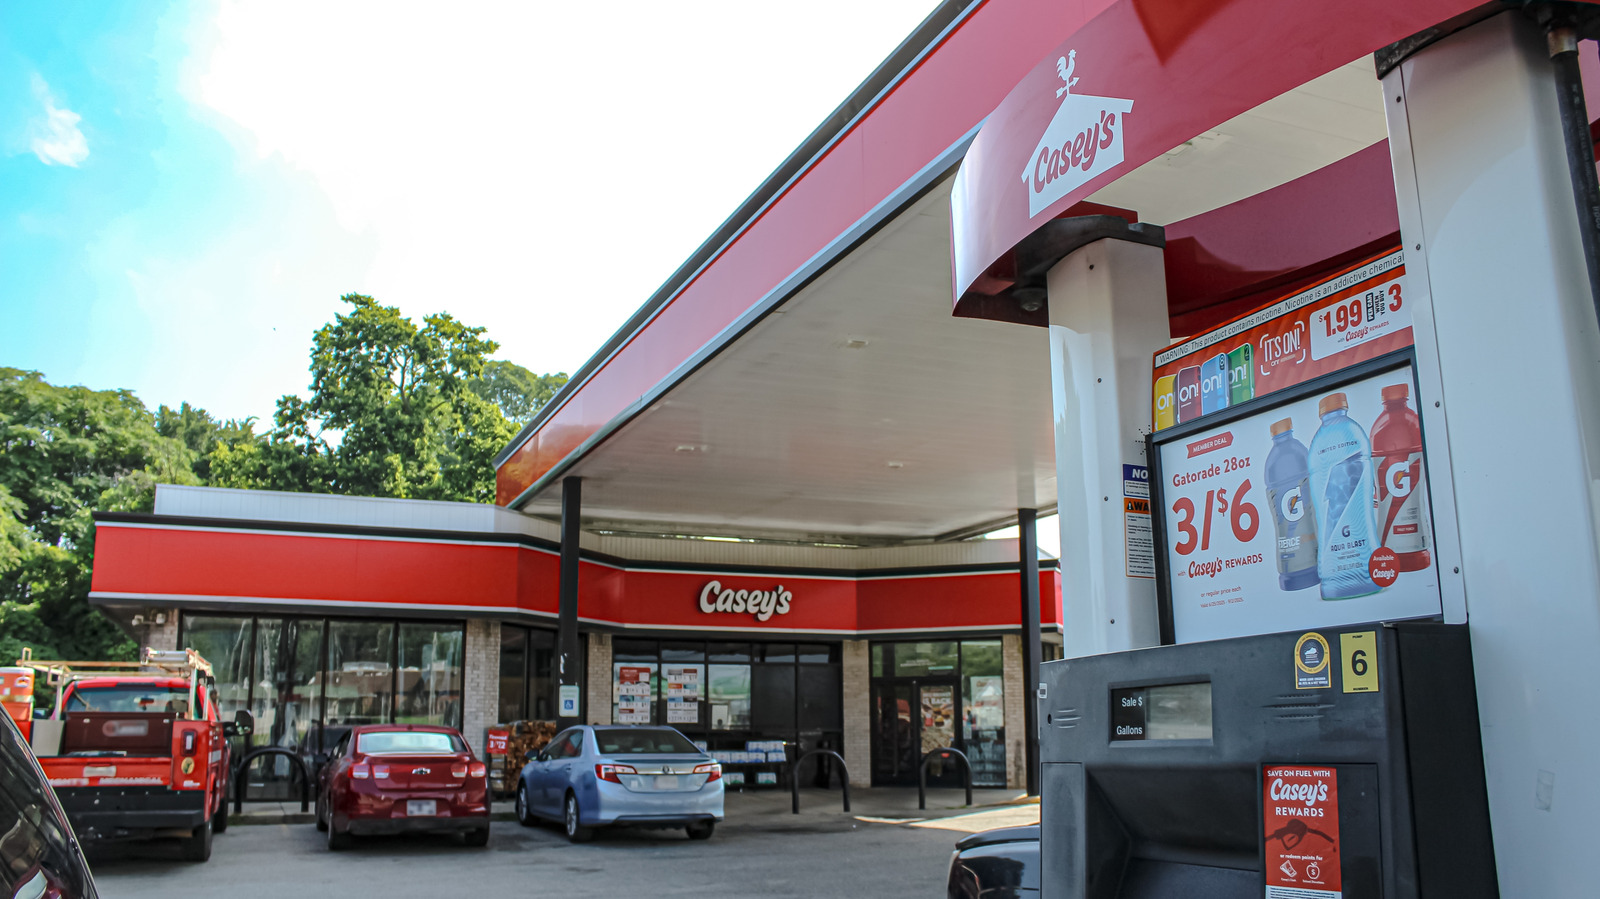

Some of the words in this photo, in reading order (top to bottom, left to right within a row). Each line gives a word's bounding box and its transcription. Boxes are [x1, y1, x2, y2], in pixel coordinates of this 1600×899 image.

[1033, 109, 1116, 193] Casey's
[1160, 345, 1190, 363] WARNING:
[1191, 340, 1203, 350] This
[1204, 330, 1227, 346] product
[1228, 318, 1255, 335] contains
[1255, 306, 1284, 323] nicotine.
[1285, 292, 1314, 311] Nicotine
[1315, 290, 1322, 299] is
[1323, 285, 1332, 295] an
[1333, 269, 1367, 290] addictive
[1369, 252, 1405, 275] chemical
[1388, 283, 1403, 313] 3
[1319, 299, 1362, 337] $1.99
[1283, 328, 1301, 355] ON!
[1345, 326, 1369, 342] Casey's
[1369, 321, 1390, 332] REWARDS
[1179, 382, 1200, 403] on!
[1202, 373, 1223, 394] on!
[1193, 440, 1214, 453] MEMBER
[1214, 437, 1228, 446] DEAL
[1317, 445, 1337, 456] LIMITED
[1338, 440, 1358, 449] EDITION
[1172, 463, 1221, 487] Gatorade
[1223, 456, 1251, 474] 28oz
[1385, 460, 1411, 498] G
[1281, 485, 1305, 522] G
[1341, 525, 1351, 538] G
[1331, 543, 1346, 552] AQUA
[1347, 539, 1367, 550] BLAST
[1188, 557, 1223, 579] Casey's
[1225, 553, 1263, 569] REWARDS
[1373, 554, 1395, 562] Available
[1372, 568, 1396, 580] Casey's
[700, 580, 793, 621] Casey's
[1206, 590, 1220, 598] regular
[1352, 649, 1368, 677] 6
[1121, 698, 1137, 708] Sale
[1138, 696, 1143, 707] $
[1116, 725, 1143, 735] Gallons
[1270, 778, 1329, 806] Casey's
[1275, 807, 1325, 817] REWARDS
